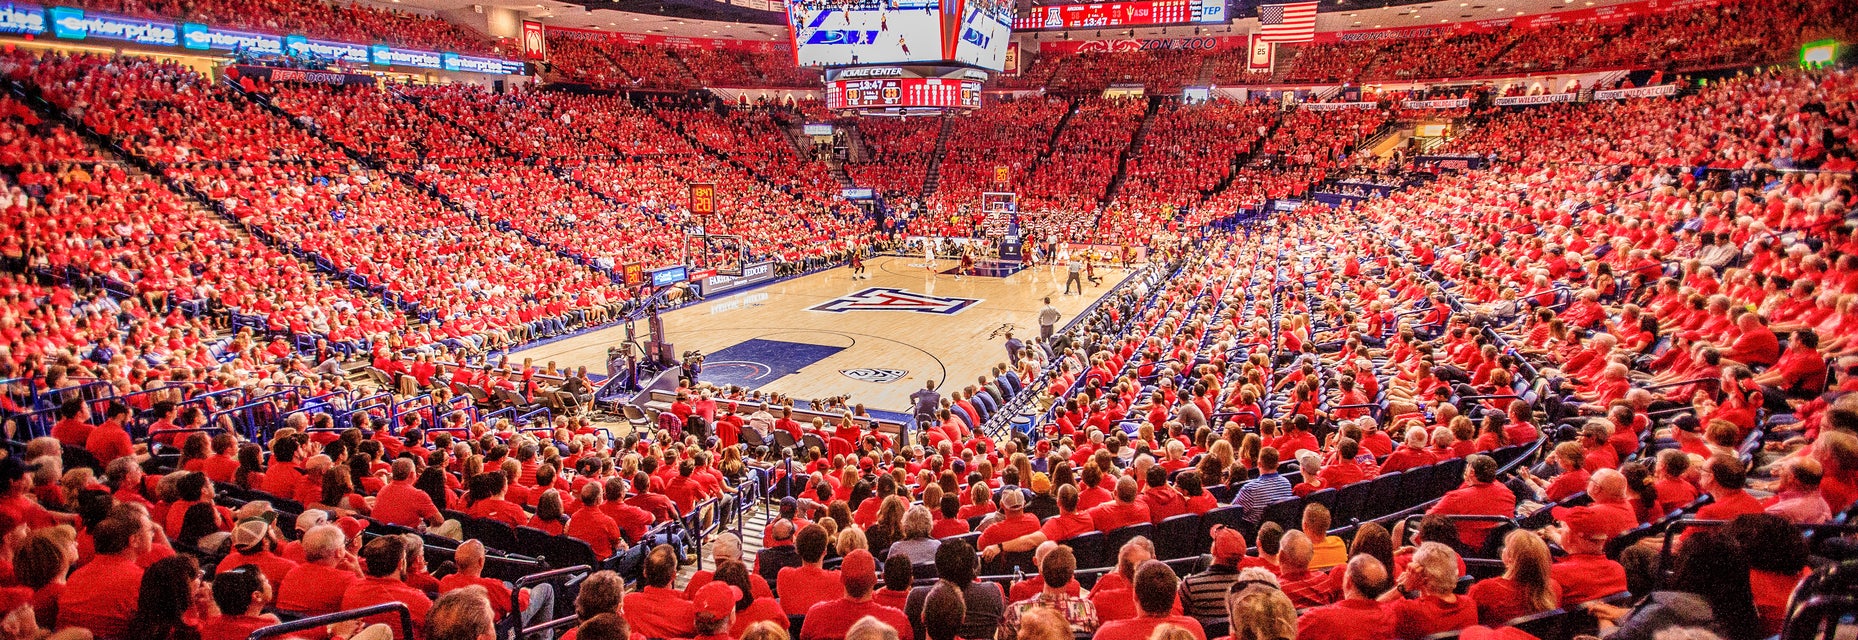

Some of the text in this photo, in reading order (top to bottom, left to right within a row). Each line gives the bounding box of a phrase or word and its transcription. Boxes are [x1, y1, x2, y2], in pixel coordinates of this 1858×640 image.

[1112, 10, 1121, 18] 33
[1134, 9, 1149, 17] ASU
[1203, 6, 1221, 15] TEP
[1083, 17, 1107, 26] 13:47
[57, 16, 175, 39] enterprise
[184, 30, 280, 48] enterprise
[288, 41, 367, 57] enterprise
[1256, 48, 1266, 56] 25
[373, 50, 440, 65] enterprise
[445, 58, 502, 71] enterprise
[869, 67, 902, 76] CENTER
[860, 81, 883, 90] 13:47
[885, 88, 898, 99] 33
[1600, 90, 1623, 99] STUDENT
[1655, 86, 1674, 95] CLUB
[1496, 94, 1569, 105] STUDENT WILDCAT CLUB
[696, 197, 711, 212] 20
[628, 273, 638, 283] 20
